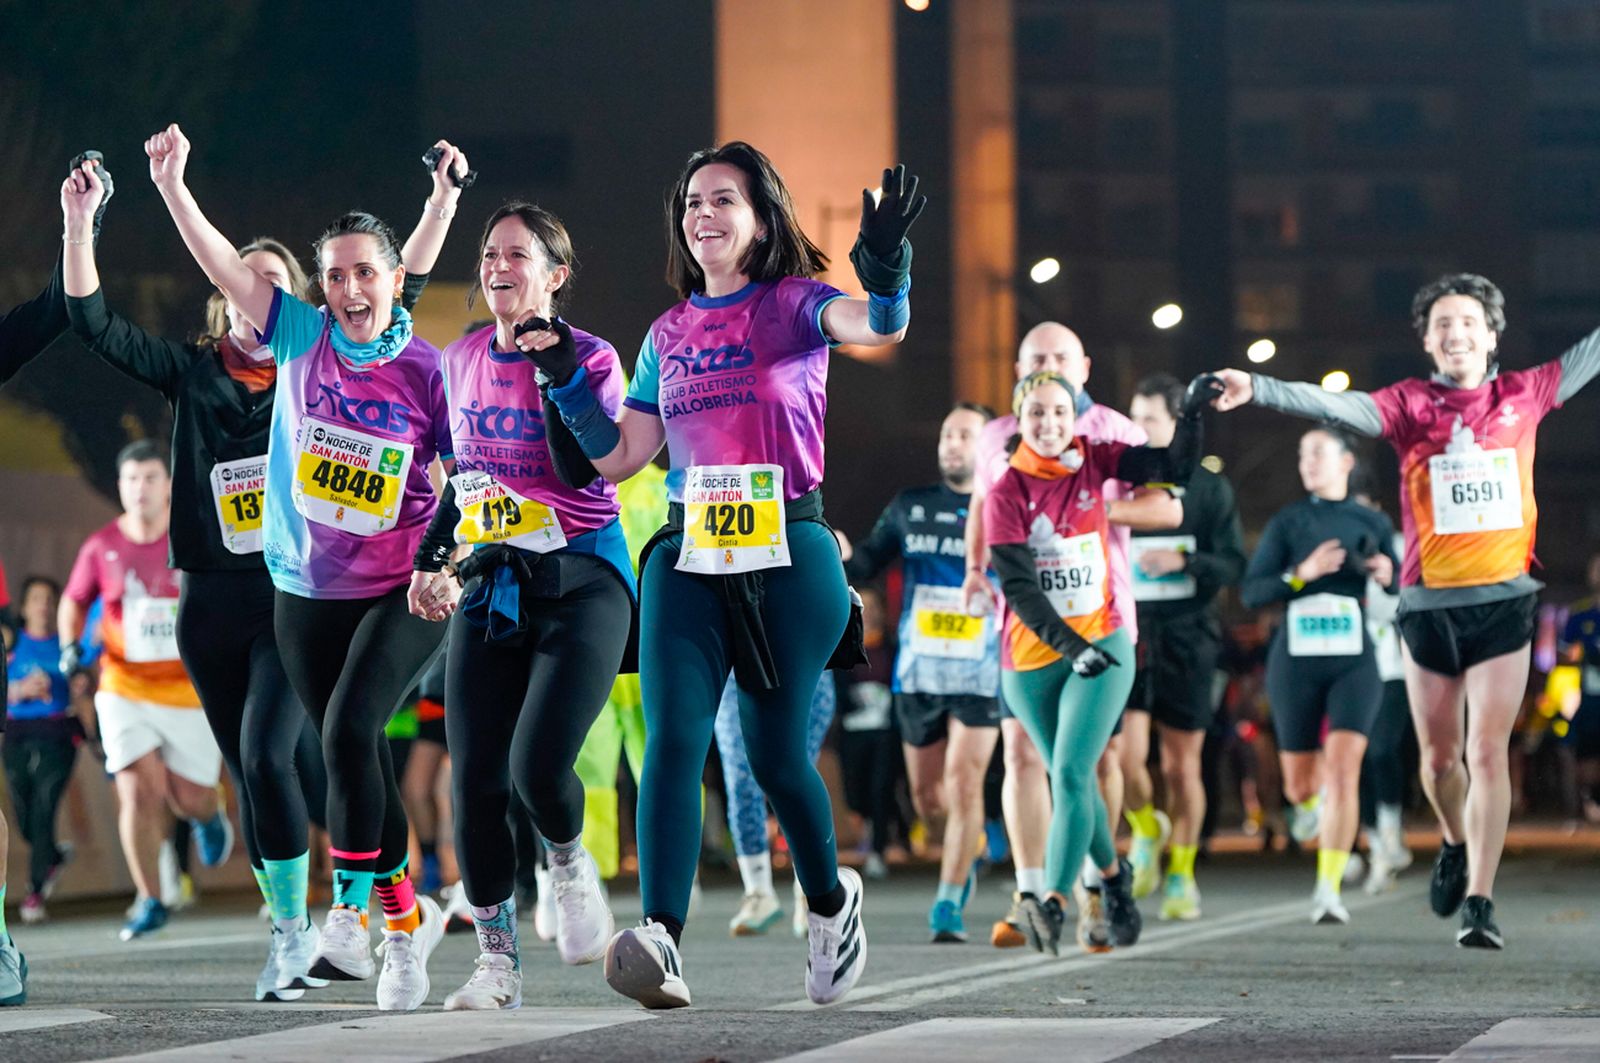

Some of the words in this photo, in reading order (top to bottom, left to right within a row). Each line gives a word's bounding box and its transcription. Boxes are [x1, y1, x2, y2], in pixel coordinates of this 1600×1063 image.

[490, 379, 514, 388] vive
[662, 386, 686, 401] CLUB
[688, 374, 757, 396] ATLETISMO
[663, 389, 758, 420] SALOBREÑA
[310, 443, 332, 458] SAN
[333, 451, 370, 469] ANTÓN
[325, 436, 358, 453] NOCHE
[359, 445, 373, 457] DE
[454, 444, 472, 456] LUB
[474, 445, 547, 462] ATLETISMO
[234, 466, 263, 480] NOCHE
[457, 459, 546, 478] AOBREÑA
[225, 481, 244, 494] SAN
[246, 478, 265, 491] ANT
[312, 459, 385, 503] 4848
[700, 478, 727, 489] NOCHE
[730, 478, 741, 488] DE
[329, 493, 358, 508] Salvador
[708, 487, 742, 502] ANTÓN
[1452, 480, 1504, 505] 6591
[230, 490, 265, 522] 13
[704, 504, 755, 536] 420
[718, 538, 738, 547] Cintia
[905, 534, 939, 554] SAN
[940, 537, 966, 557] AN
[1040, 565, 1093, 591] 6592
